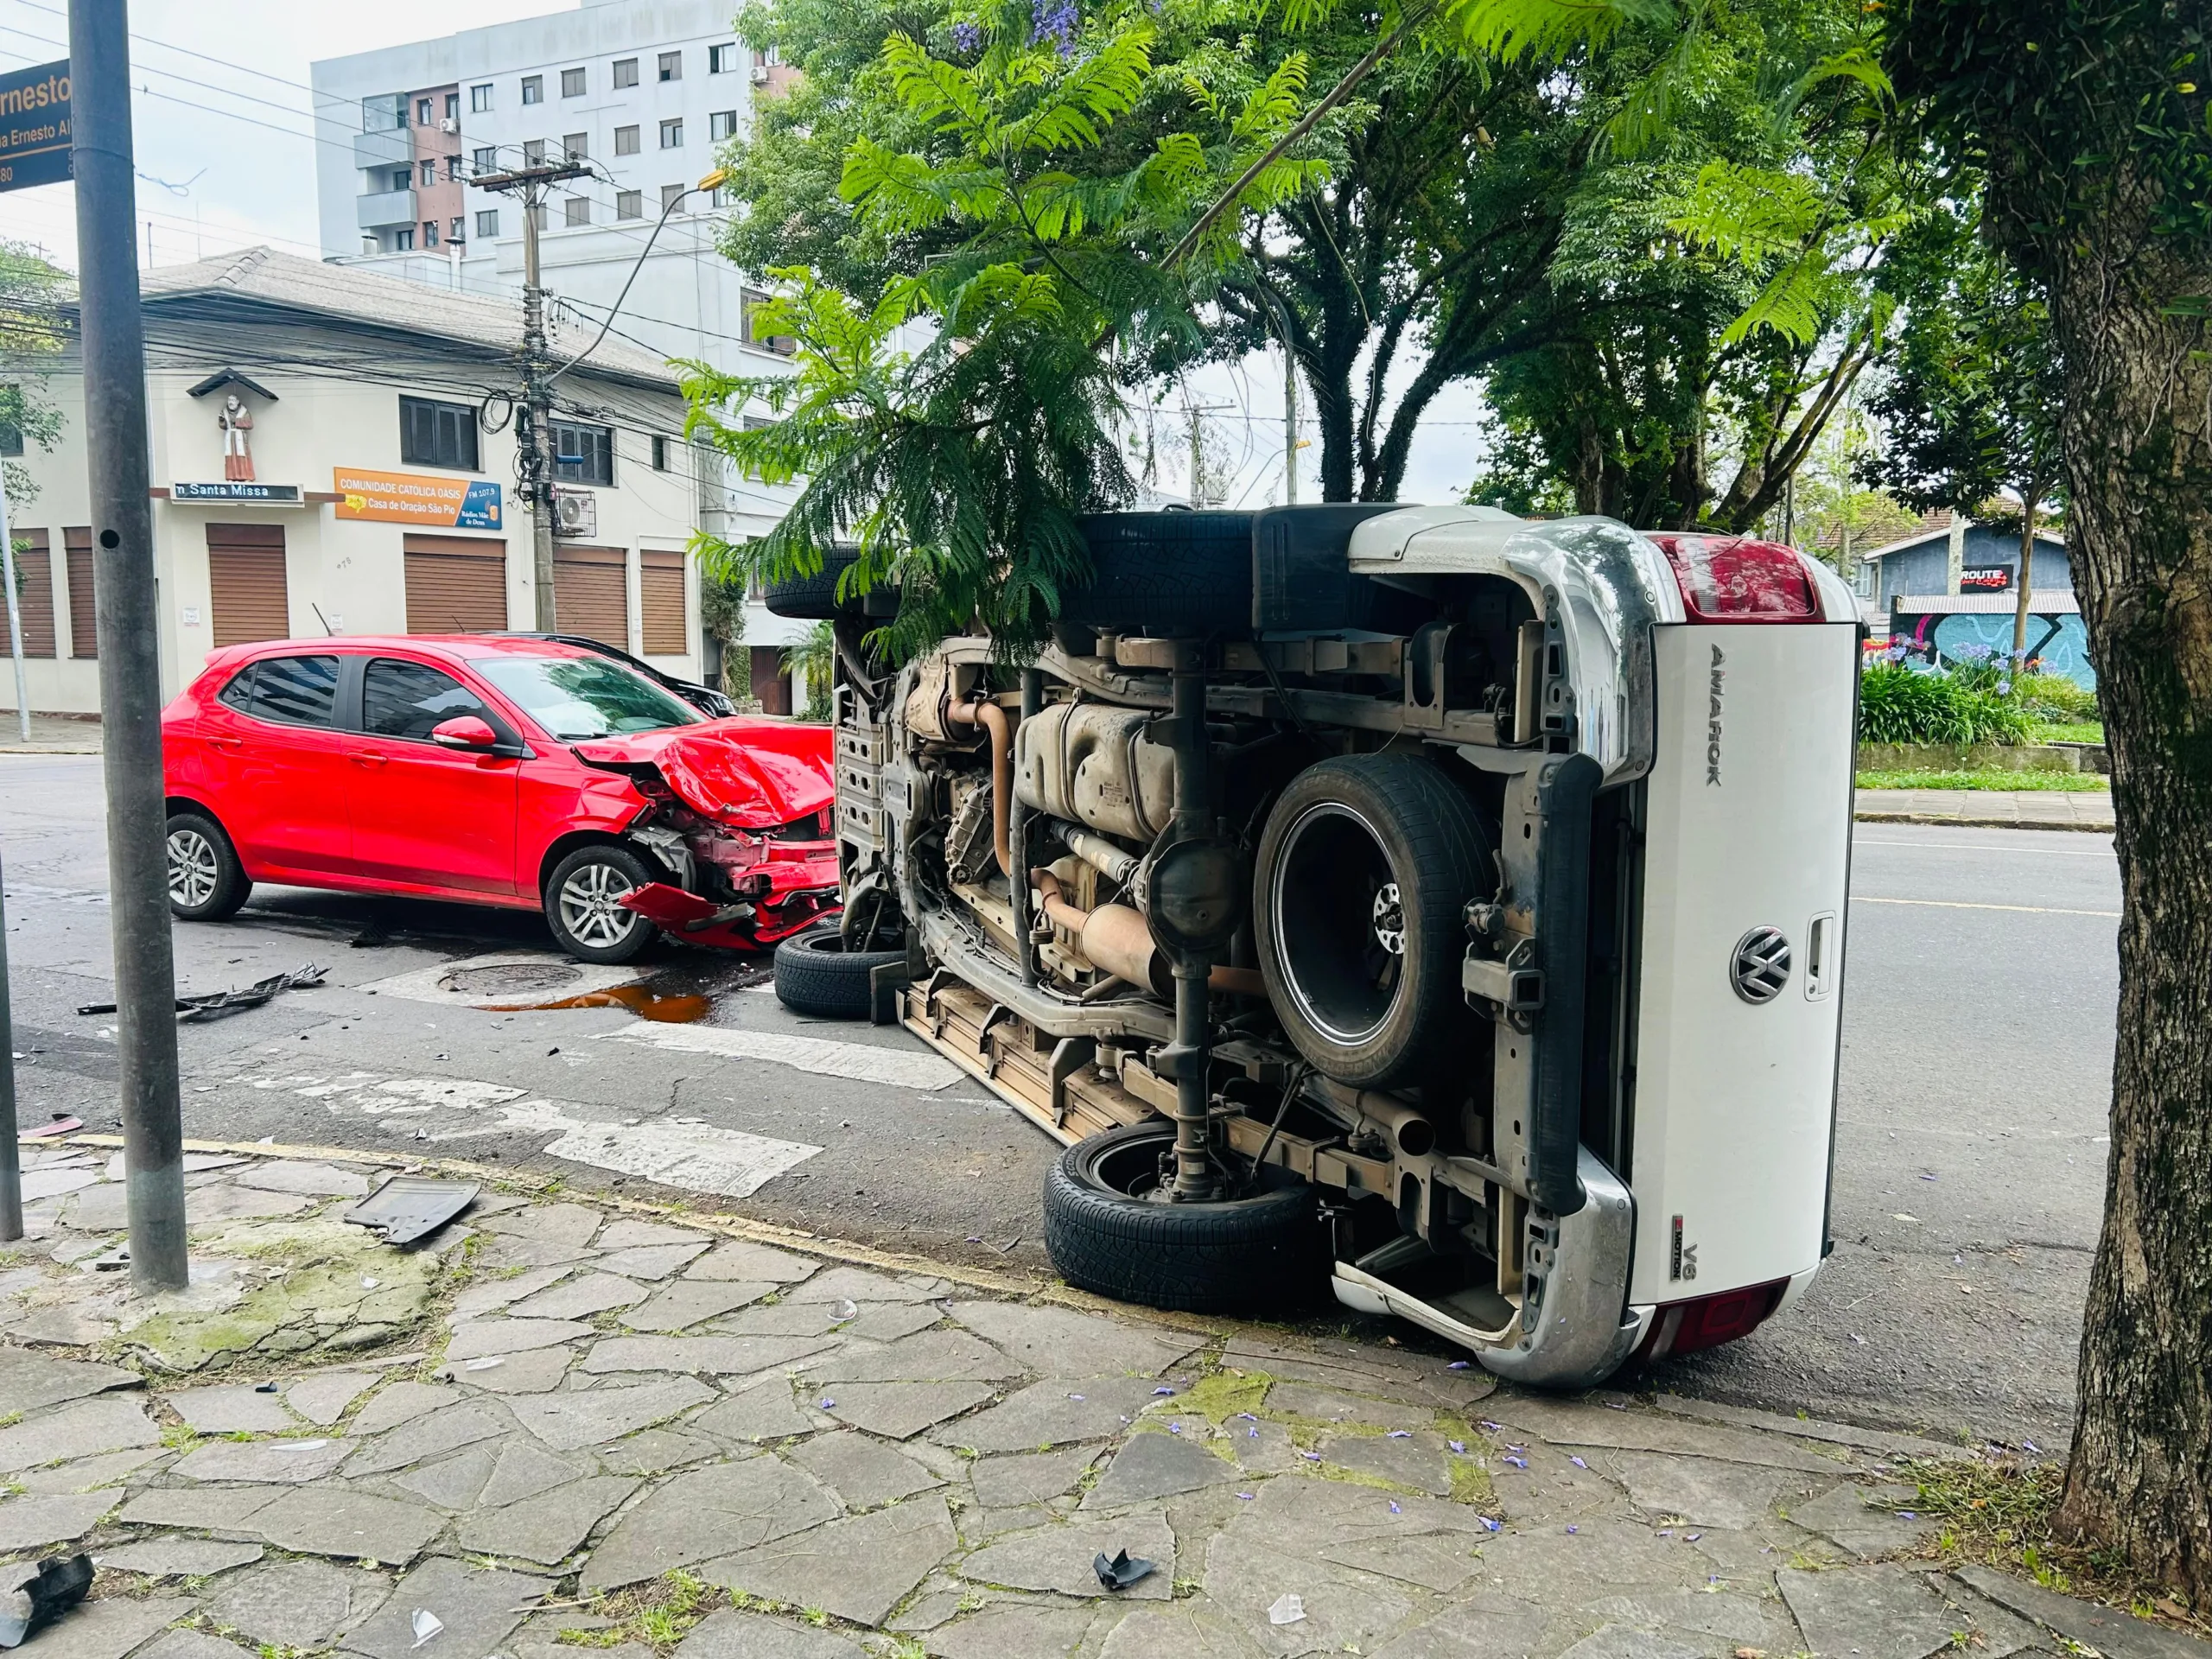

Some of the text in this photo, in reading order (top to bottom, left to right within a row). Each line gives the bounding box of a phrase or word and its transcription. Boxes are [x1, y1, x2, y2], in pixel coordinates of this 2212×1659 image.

[11, 124, 55, 145] Ernesto
[190, 484, 226, 495] Santa
[231, 486, 269, 496] Missa
[340, 479, 397, 493] COMUNIDADE
[399, 483, 436, 497] CATÓLICA
[368, 498, 455, 515] Casa de Oração São Pio
[1706, 643, 1726, 787] AMAROK
[1682, 1242, 1698, 1281] V6
